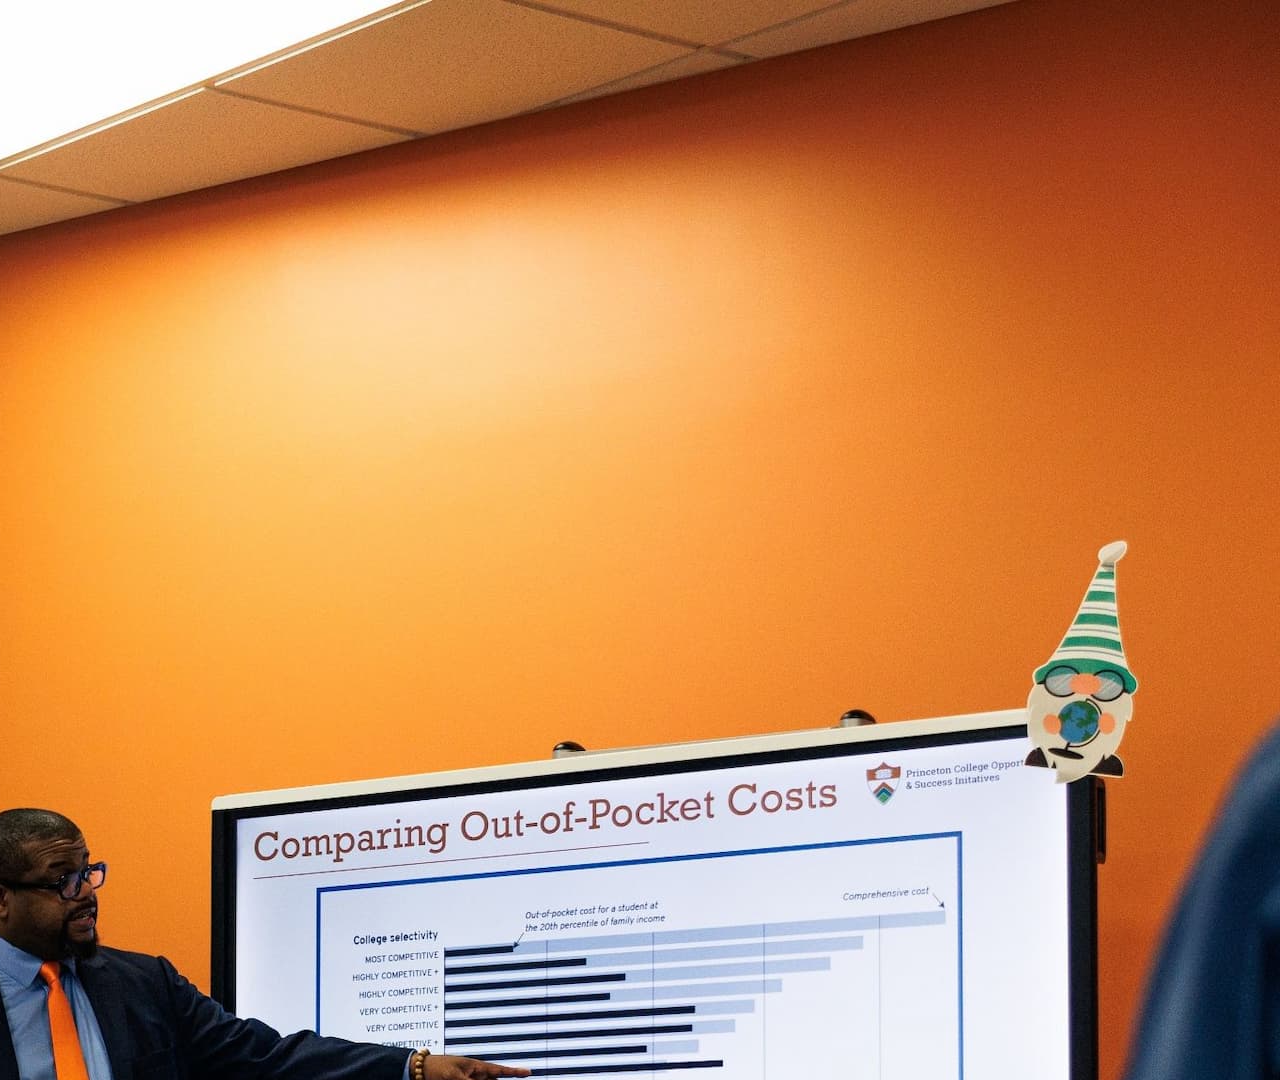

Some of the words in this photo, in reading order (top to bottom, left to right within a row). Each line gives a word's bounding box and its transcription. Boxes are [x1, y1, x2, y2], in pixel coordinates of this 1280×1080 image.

[906, 766, 951, 778] Princeton
[954, 762, 989, 774] College
[991, 759, 1025, 771] Opport
[905, 781, 912, 789] &
[915, 778, 952, 789] Success
[955, 773, 1000, 785] Initatives
[254, 818, 449, 863] Comparing
[460, 790, 715, 841] Out-of-Pocket
[728, 781, 838, 816] Costs
[842, 887, 909, 901] Comprehensive
[911, 886, 930, 896] cost
[525, 907, 578, 919] Out-of-pocket
[580, 906, 596, 915] cost
[597, 905, 610, 914] for
[618, 903, 648, 912] student
[649, 901, 659, 910] at
[525, 924, 538, 932] the
[540, 922, 559, 931] 20th
[559, 919, 599, 931] percentile
[600, 917, 609, 926] of
[610, 915, 635, 926] family
[636, 915, 666, 924] income
[353, 935, 388, 945] College
[390, 930, 438, 942] selectivity
[365, 955, 386, 963] MOST
[388, 951, 439, 962] COMPETITIVE
[352, 972, 380, 981] HIGHLY
[381, 968, 432, 980] COMPETITIVE
[359, 990, 386, 999] HIGHLY
[388, 986, 439, 998] COMPETITIVE
[359, 1007, 380, 1016] VERY
[381, 1003, 432, 1015] COMPETITIVE
[366, 1024, 386, 1032] VERY
[388, 1020, 439, 1031] COMPETITIVE
